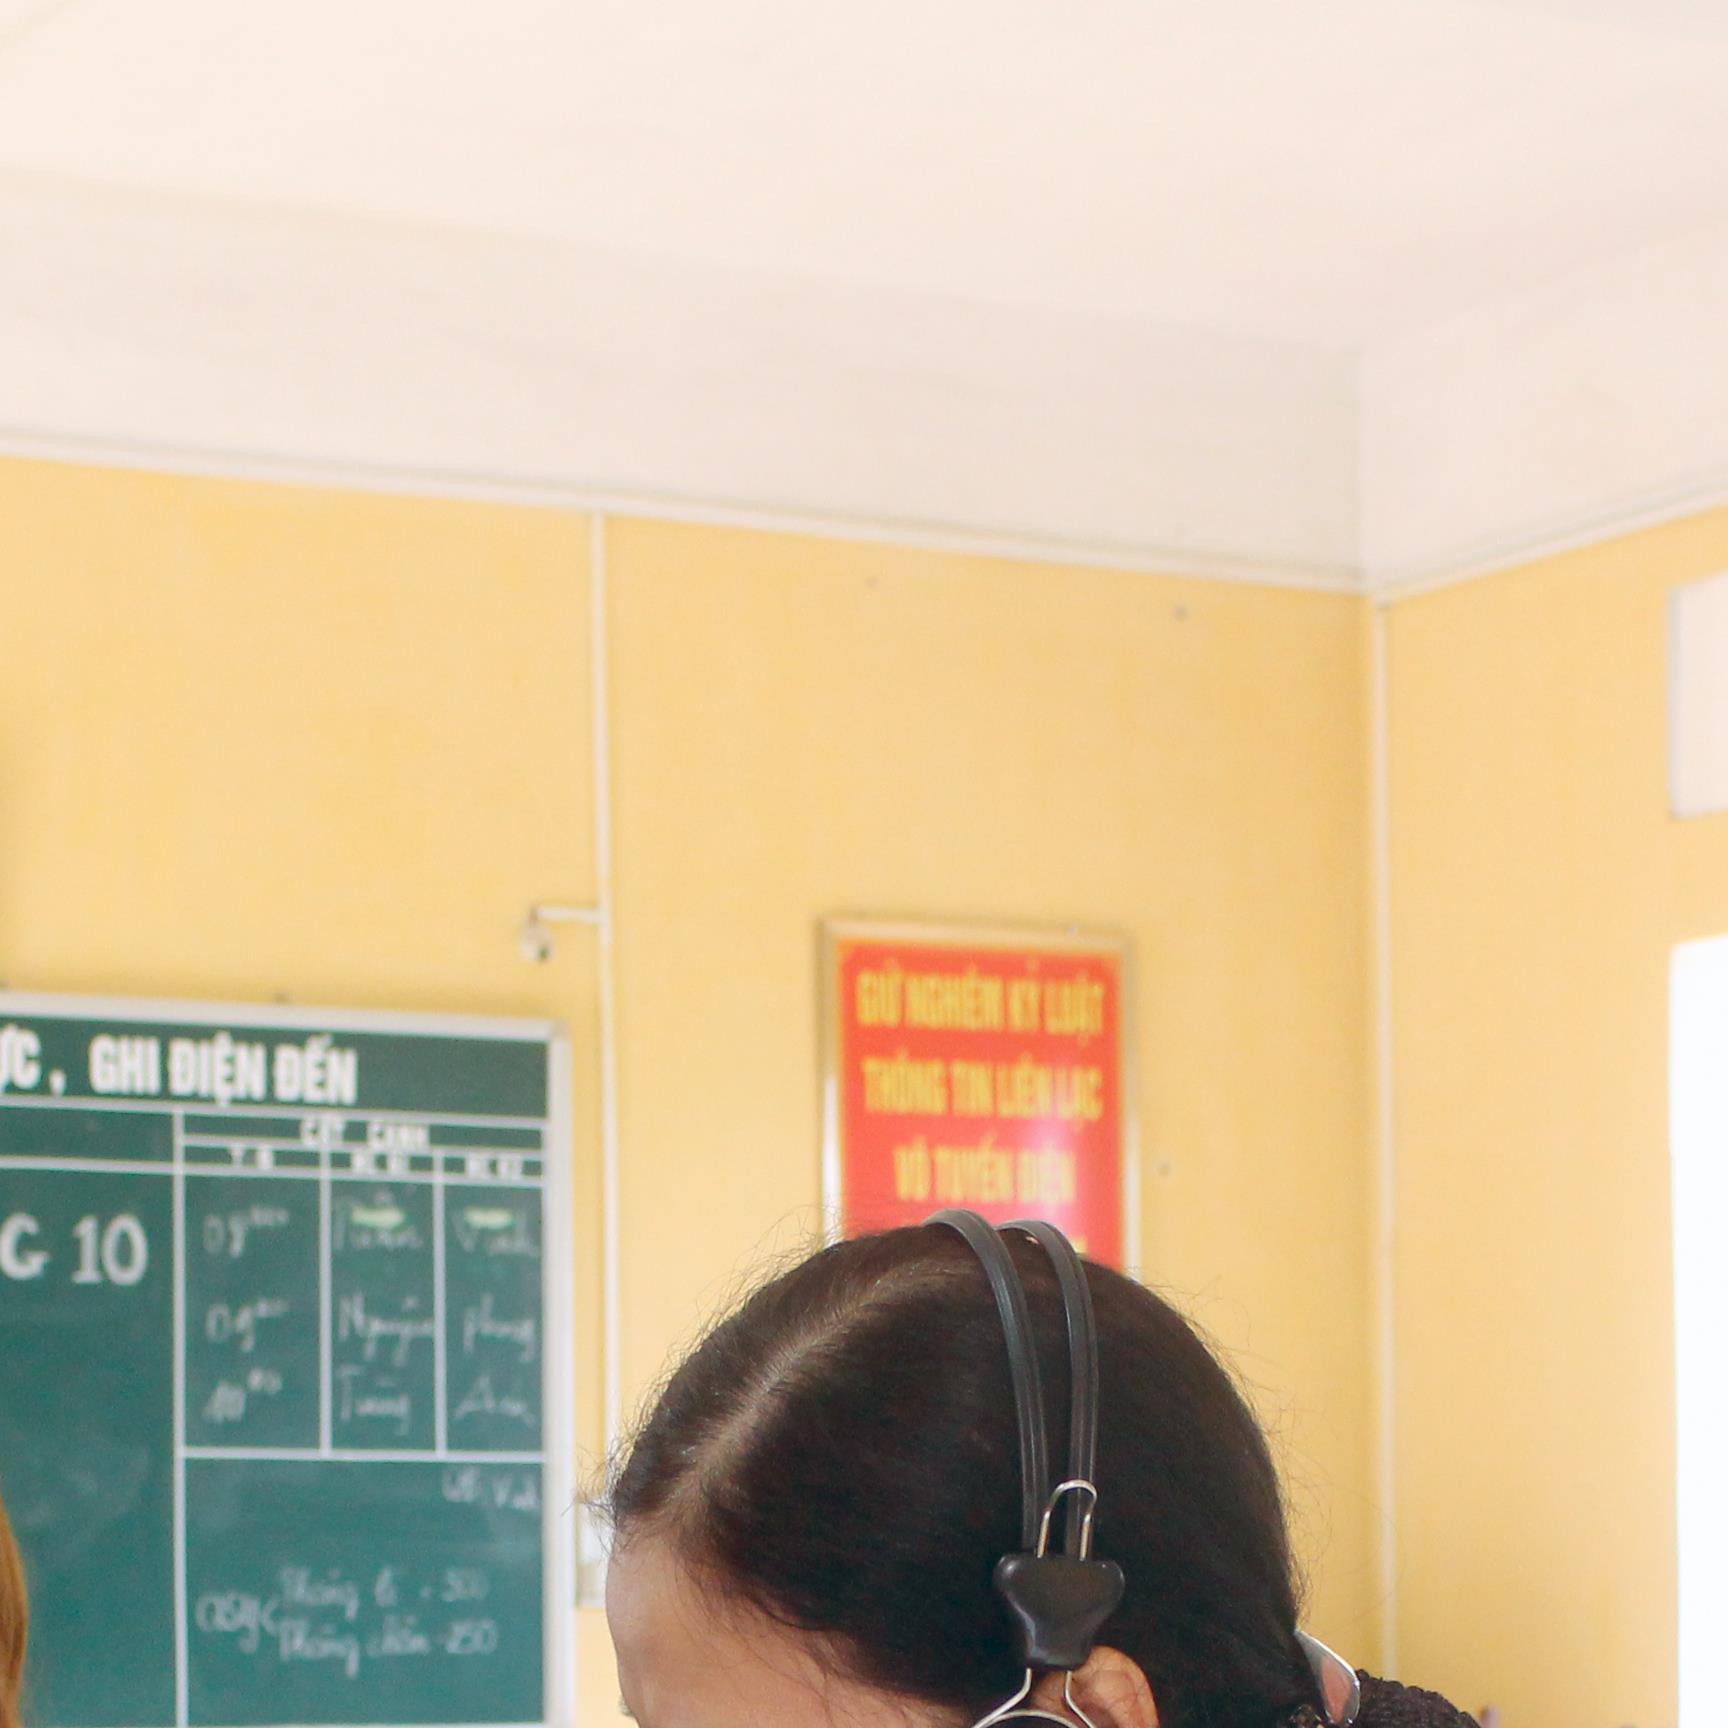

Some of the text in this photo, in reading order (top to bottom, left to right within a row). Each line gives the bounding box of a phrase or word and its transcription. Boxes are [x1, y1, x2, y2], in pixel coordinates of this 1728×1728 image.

[89, 1035, 161, 1094] GHI
[169, 1032, 266, 1107] ĐIỆN
[274, 1035, 358, 1105] ĐẾN
[72, 1213, 149, 1286] 10
